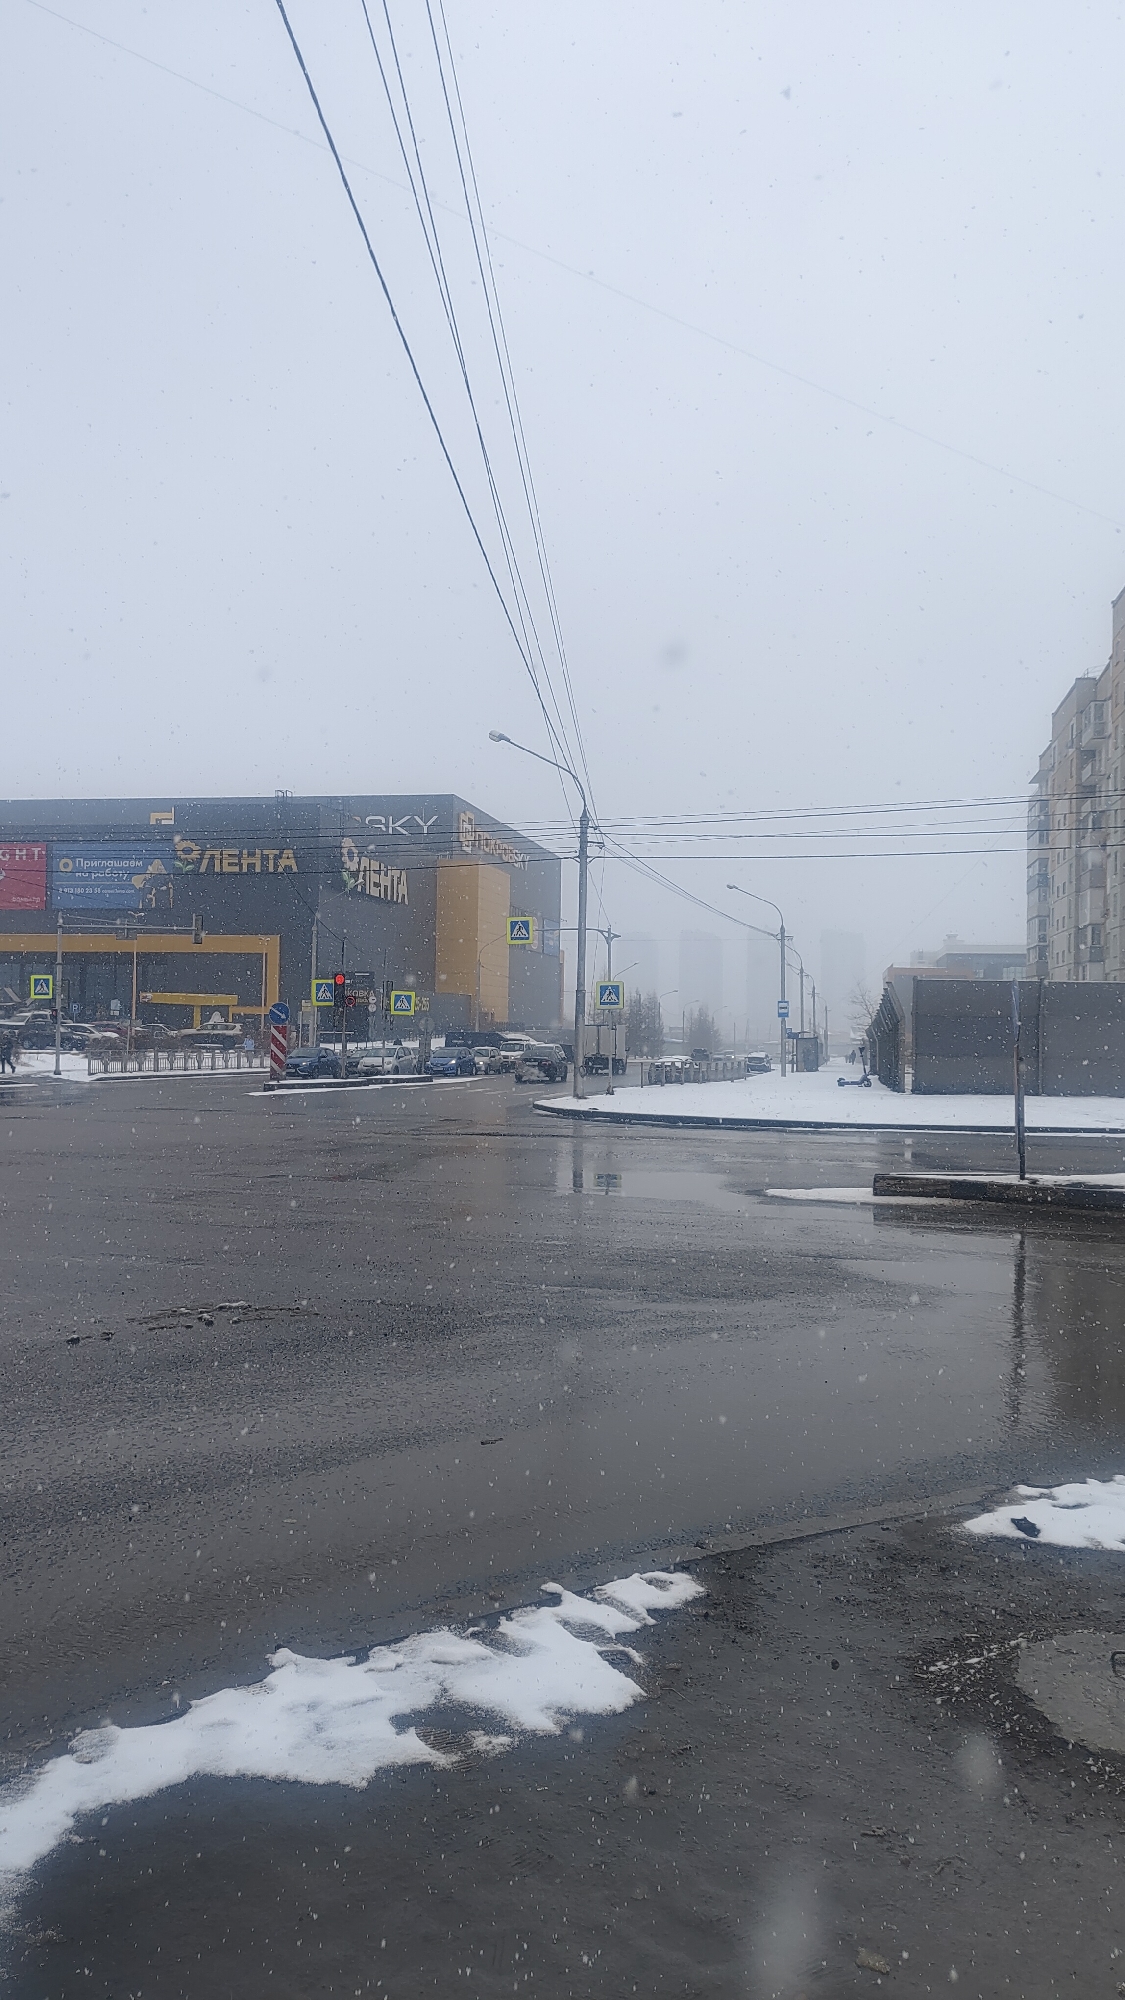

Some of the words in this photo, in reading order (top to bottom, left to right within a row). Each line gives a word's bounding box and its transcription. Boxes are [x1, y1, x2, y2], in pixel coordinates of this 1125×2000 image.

[75, 858, 143, 868] Приглашаем
[199, 849, 299, 873] ЛЕНТА
[91, 869, 130, 880] работу
[357, 856, 409, 906] ЛЕНТА
